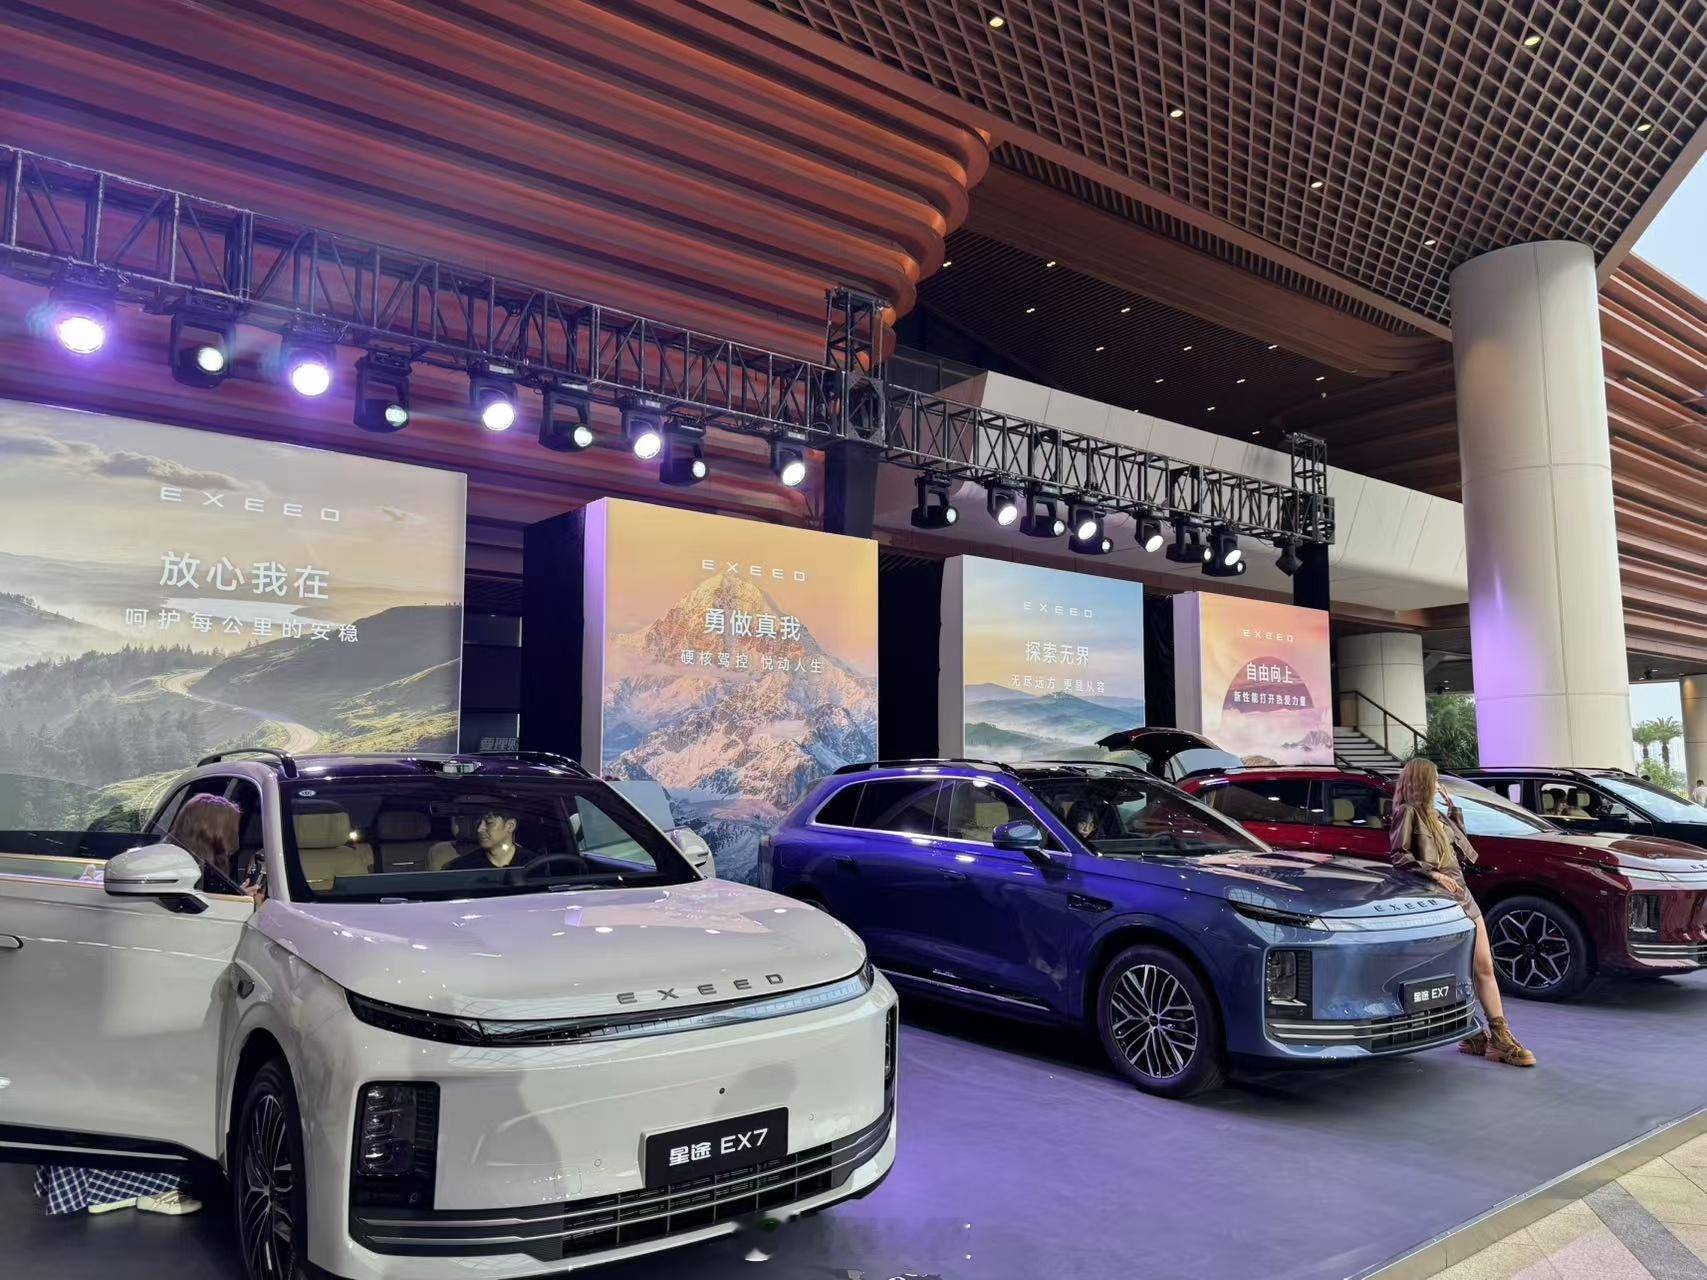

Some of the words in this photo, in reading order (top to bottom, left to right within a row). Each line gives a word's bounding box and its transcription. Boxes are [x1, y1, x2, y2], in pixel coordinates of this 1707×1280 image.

[159, 550, 331, 600] 放心我在
[125, 607, 359, 643] 呵护每公里的安稳
[704, 608, 801, 641] 勇做真我
[680, 650, 749, 669] 硬核驾控
[761, 655, 823, 674] 悦动人生
[1025, 640, 1089, 665] 探索无界
[1247, 662, 1294, 684] 自由向上
[616, 973, 784, 1004] EXEED
[1431, 985, 1449, 999] EX7
[669, 1141, 712, 1166] 星途
[720, 1128, 769, 1154] EX7
